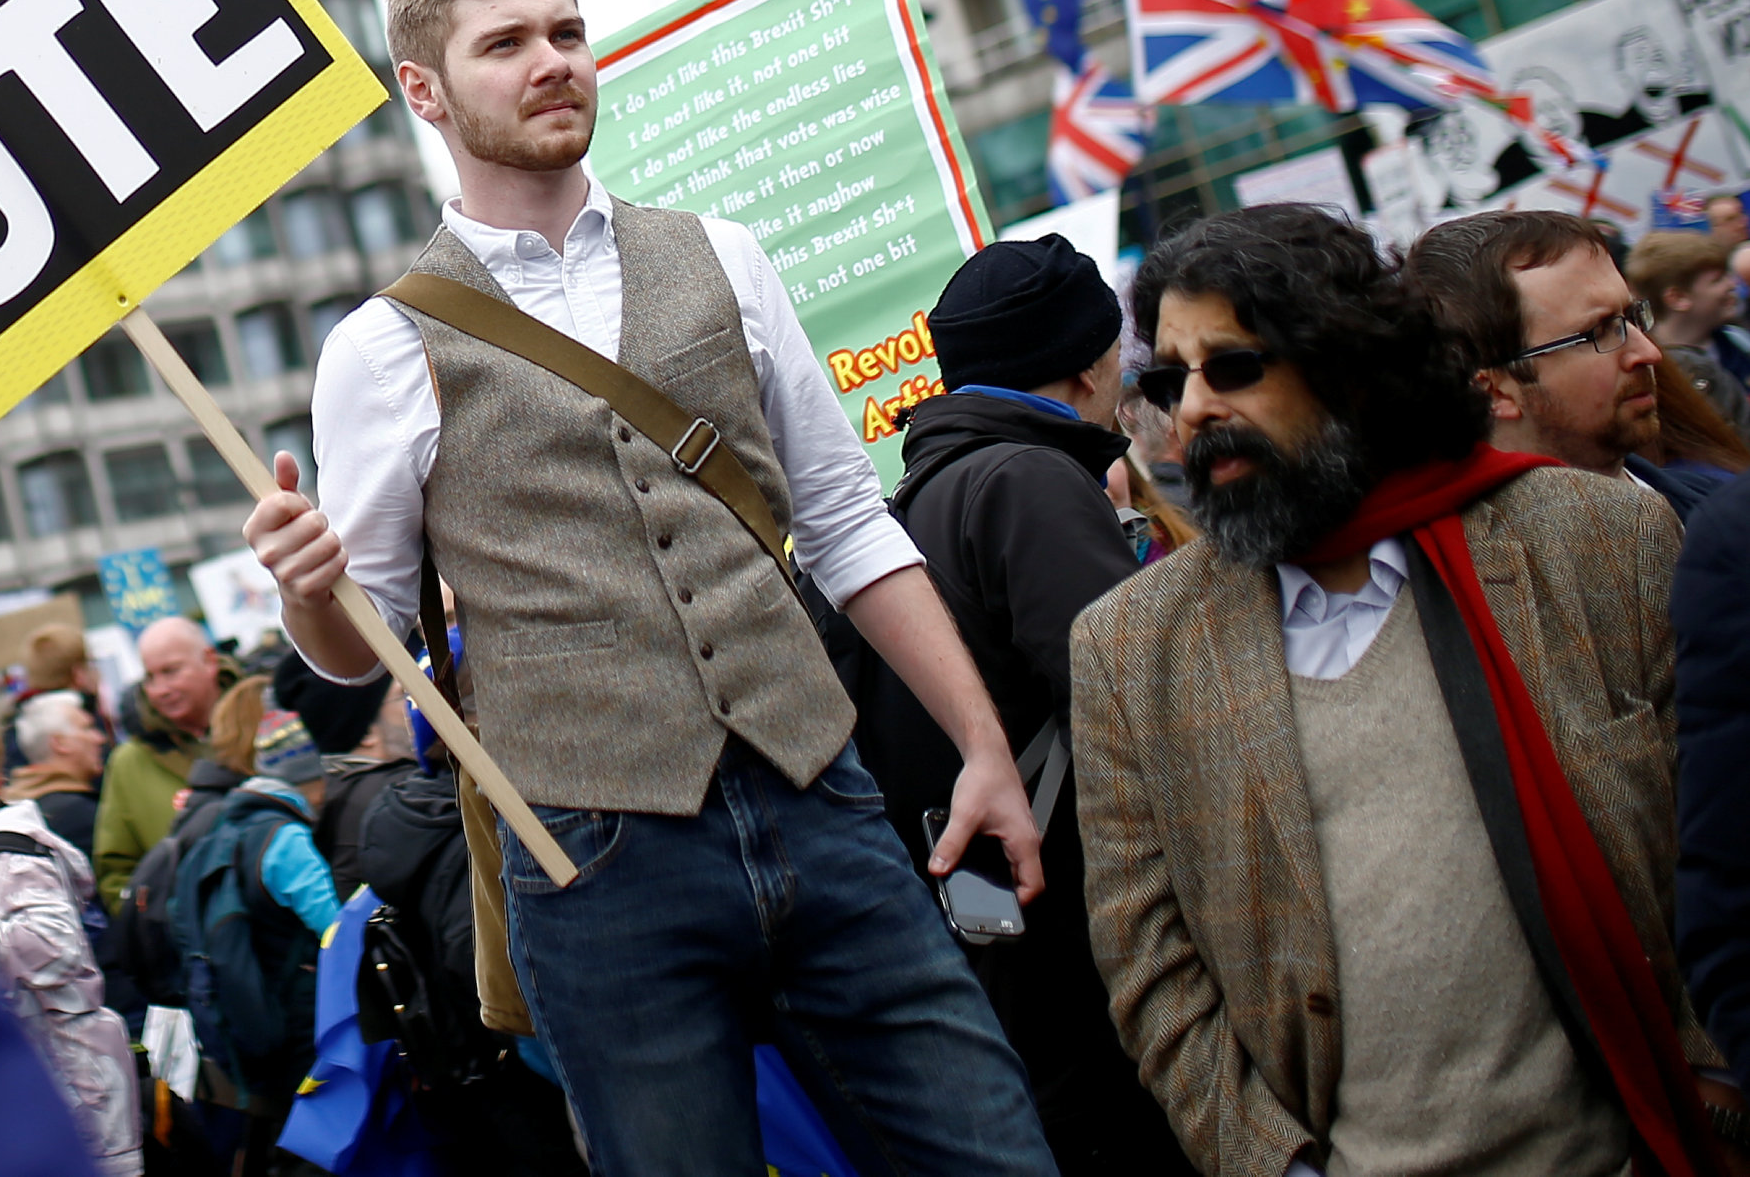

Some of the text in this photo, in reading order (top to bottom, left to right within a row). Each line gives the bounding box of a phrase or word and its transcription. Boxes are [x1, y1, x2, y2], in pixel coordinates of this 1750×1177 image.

[610, 102, 623, 121] I
[625, 93, 646, 114] do
[648, 73, 676, 102] not
[677, 61, 708, 86] like
[711, 40, 747, 67] this
[749, 9, 805, 49] Brexit
[627, 132, 638, 150] I
[641, 122, 660, 142] do
[664, 103, 690, 131] not
[693, 90, 725, 114] like
[752, 56, 782, 84] not
[787, 43, 819, 67] one
[822, 24, 850, 51] bit
[630, 59, 867, 186] I do not like the endless lies
[656, 84, 901, 210] not think that vote was wise
[721, 190, 756, 215] like
[757, 176, 775, 198] it
[778, 164, 821, 189] then
[824, 147, 844, 168] or
[848, 129, 885, 157] now
[771, 246, 809, 273] this
[810, 215, 868, 256] Brexit
[784, 204, 802, 226] it
[807, 175, 875, 214] anyhow
[817, 264, 849, 293] not
[852, 253, 886, 277] one
[886, 234, 918, 262] bit
